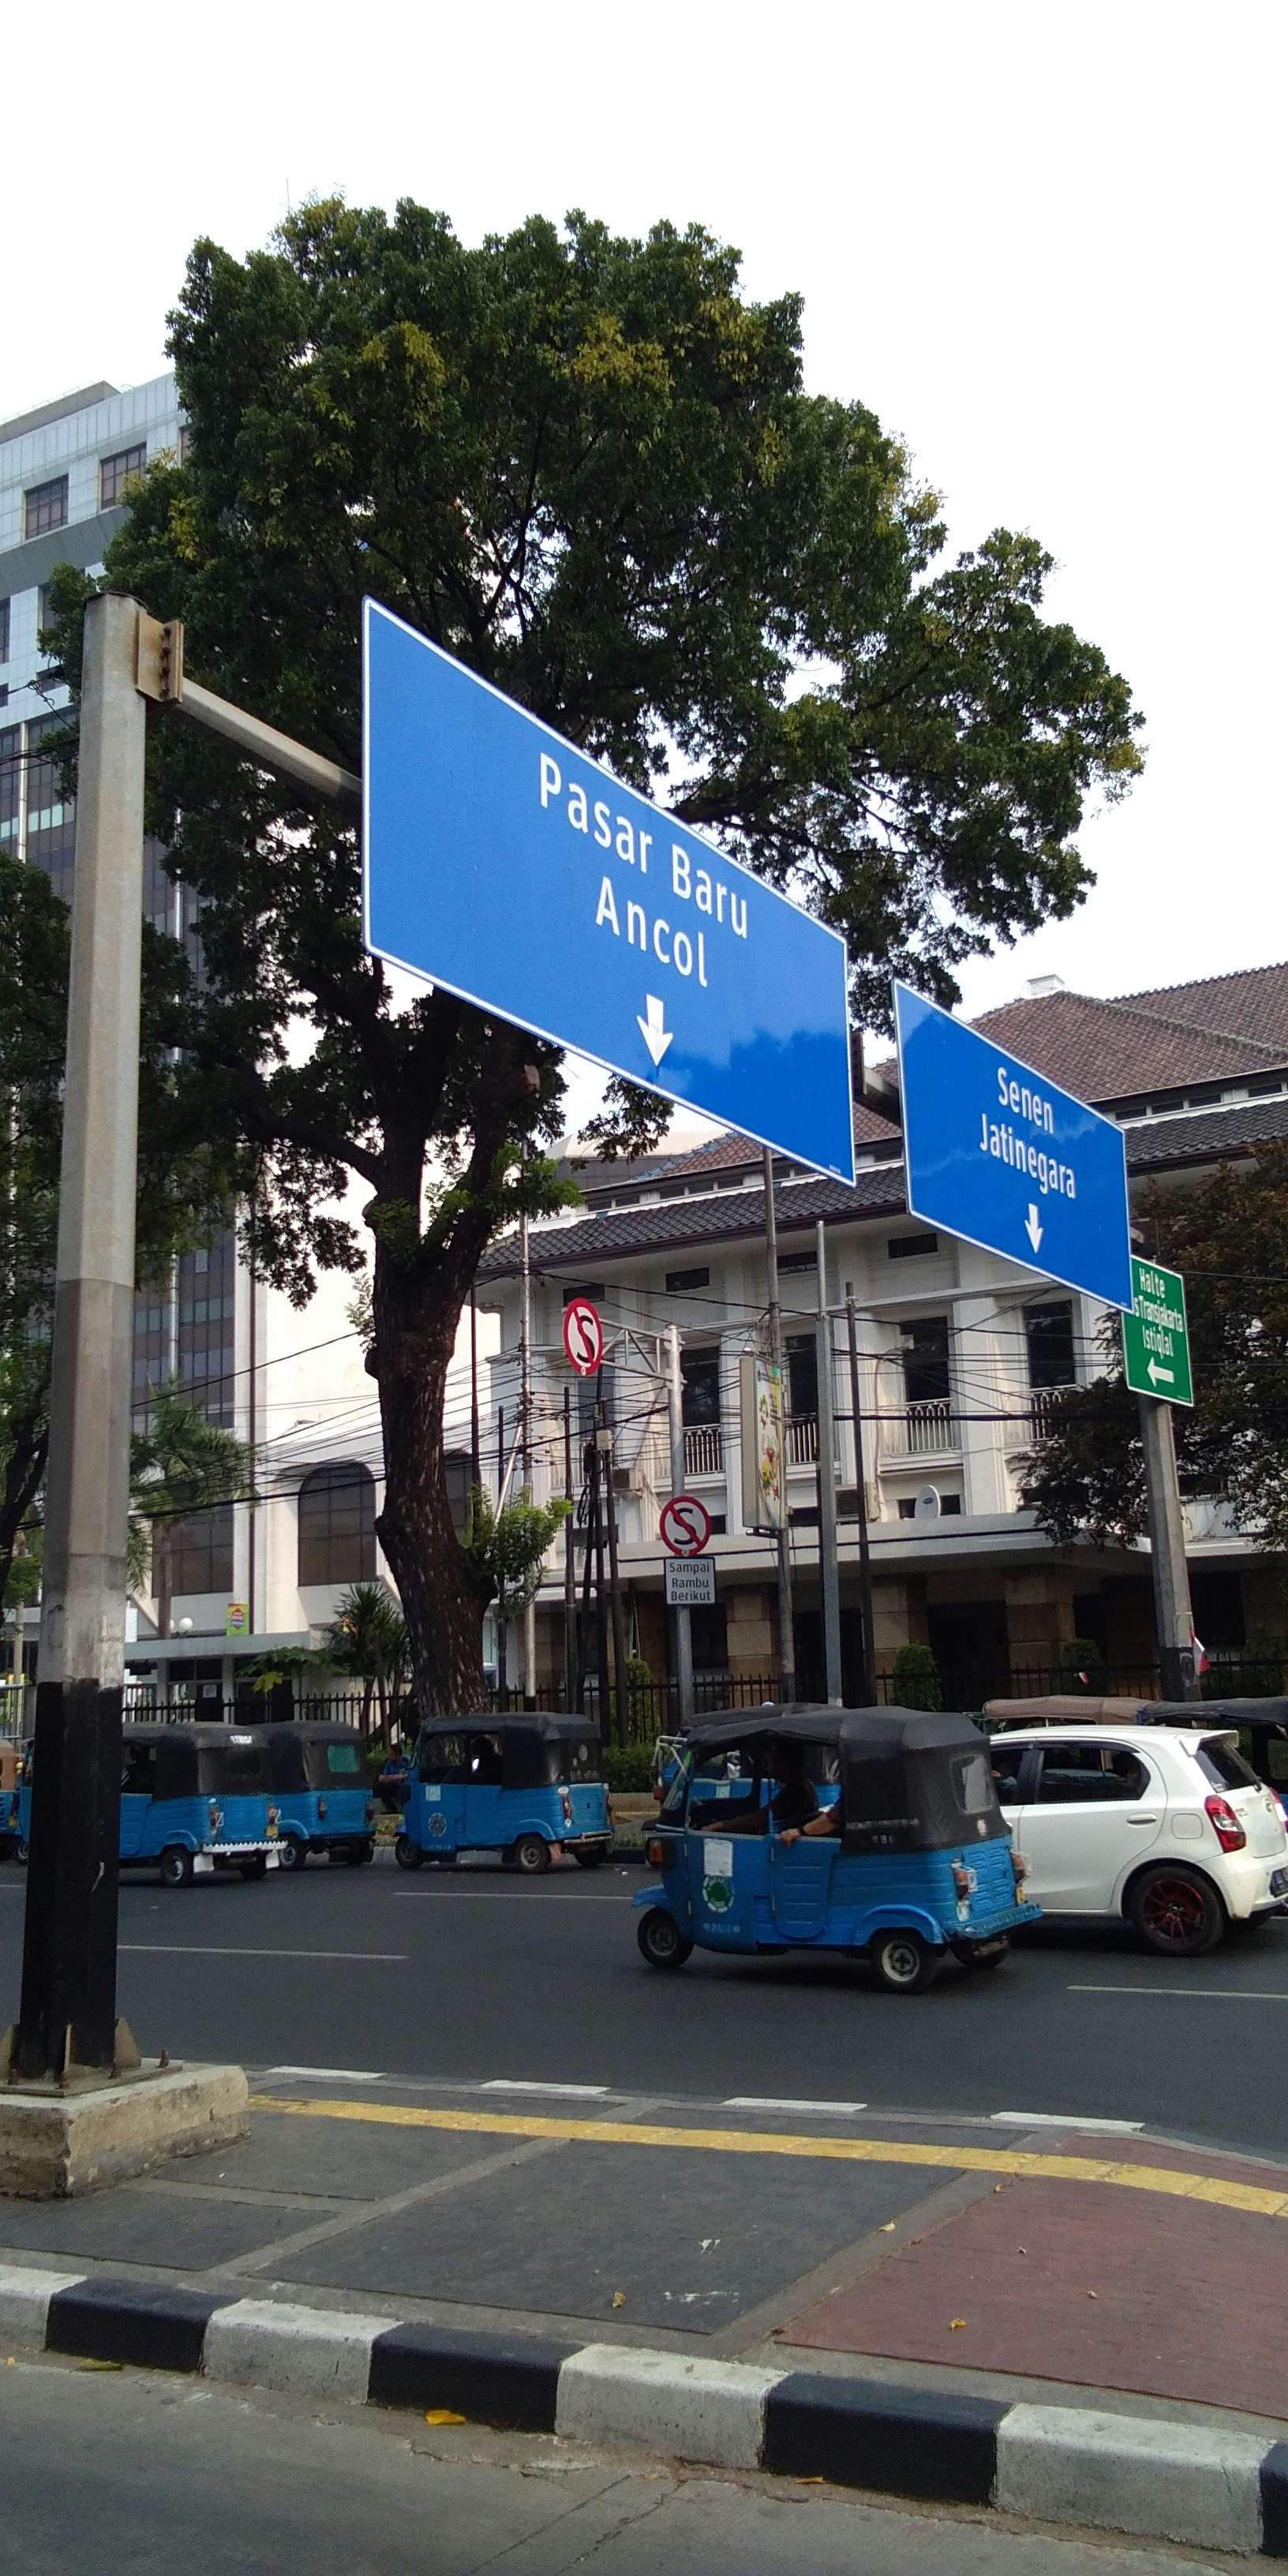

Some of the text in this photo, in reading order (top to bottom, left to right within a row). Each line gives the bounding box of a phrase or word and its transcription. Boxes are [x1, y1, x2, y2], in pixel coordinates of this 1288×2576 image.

[540, 753, 748, 938] Pasar Baru
[596, 876, 708, 987] Ancol
[998, 1067, 1054, 1134] Senen
[979, 1114, 1076, 1200] Jatinegara
[1138, 1267, 1166, 1299] Halte
[1141, 1324, 1174, 1360] Istiqlal
[668, 1561, 710, 1575] Sampai
[671, 1577, 710, 1588] Rambu
[670, 1589, 711, 1601] Berikut
